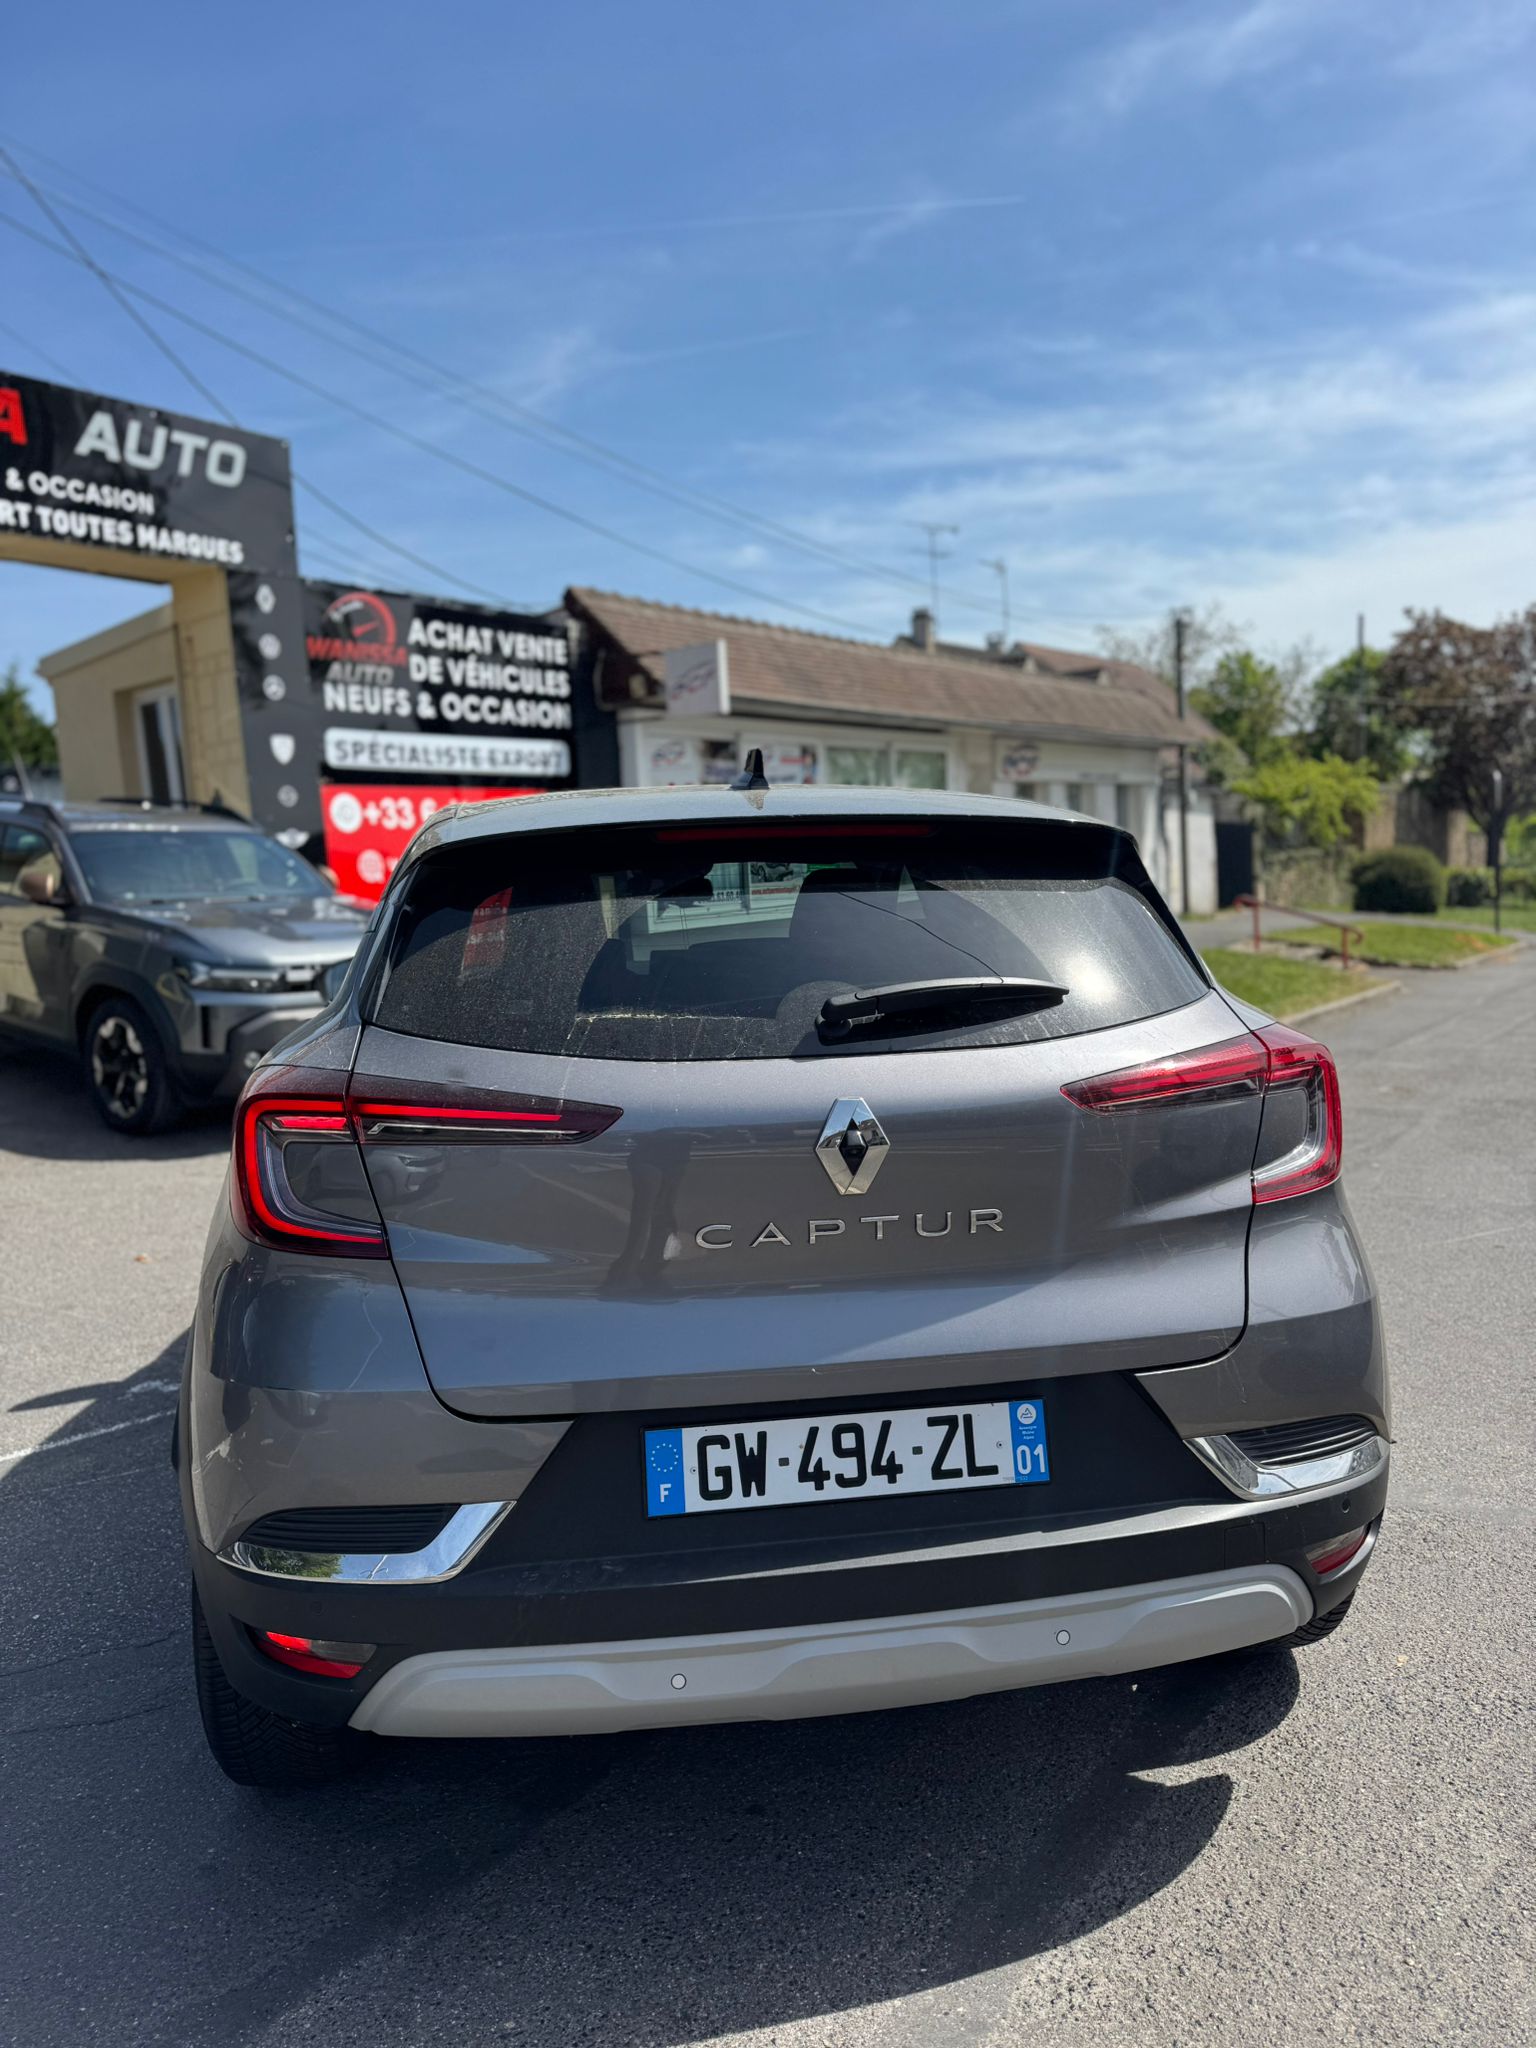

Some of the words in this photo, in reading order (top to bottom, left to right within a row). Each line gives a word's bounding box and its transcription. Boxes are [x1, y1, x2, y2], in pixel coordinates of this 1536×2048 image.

[74, 410, 247, 488] AUTO
[5, 466, 25, 492] &
[27, 470, 155, 516] OCCASION
[35, 504, 134, 545] TOUTES
[136, 522, 244, 564] MARQUES
[407, 617, 493, 655] ACHAT
[496, 630, 568, 665] VENTE
[325, 660, 394, 686] AUTO
[408, 653, 444, 685] DE
[446, 652, 571, 698] VÉHICULES
[323, 681, 412, 717] NEUFS
[416, 692, 437, 720] &
[439, 692, 572, 729] OCCASION
[363, 796, 417, 830] +33
[695, 1208, 1004, 1249] CAPTUR
[696, 1413, 999, 1501] GW-494-ZL
[1016, 1443, 1046, 1475] 01
[659, 1483, 671, 1503] F
